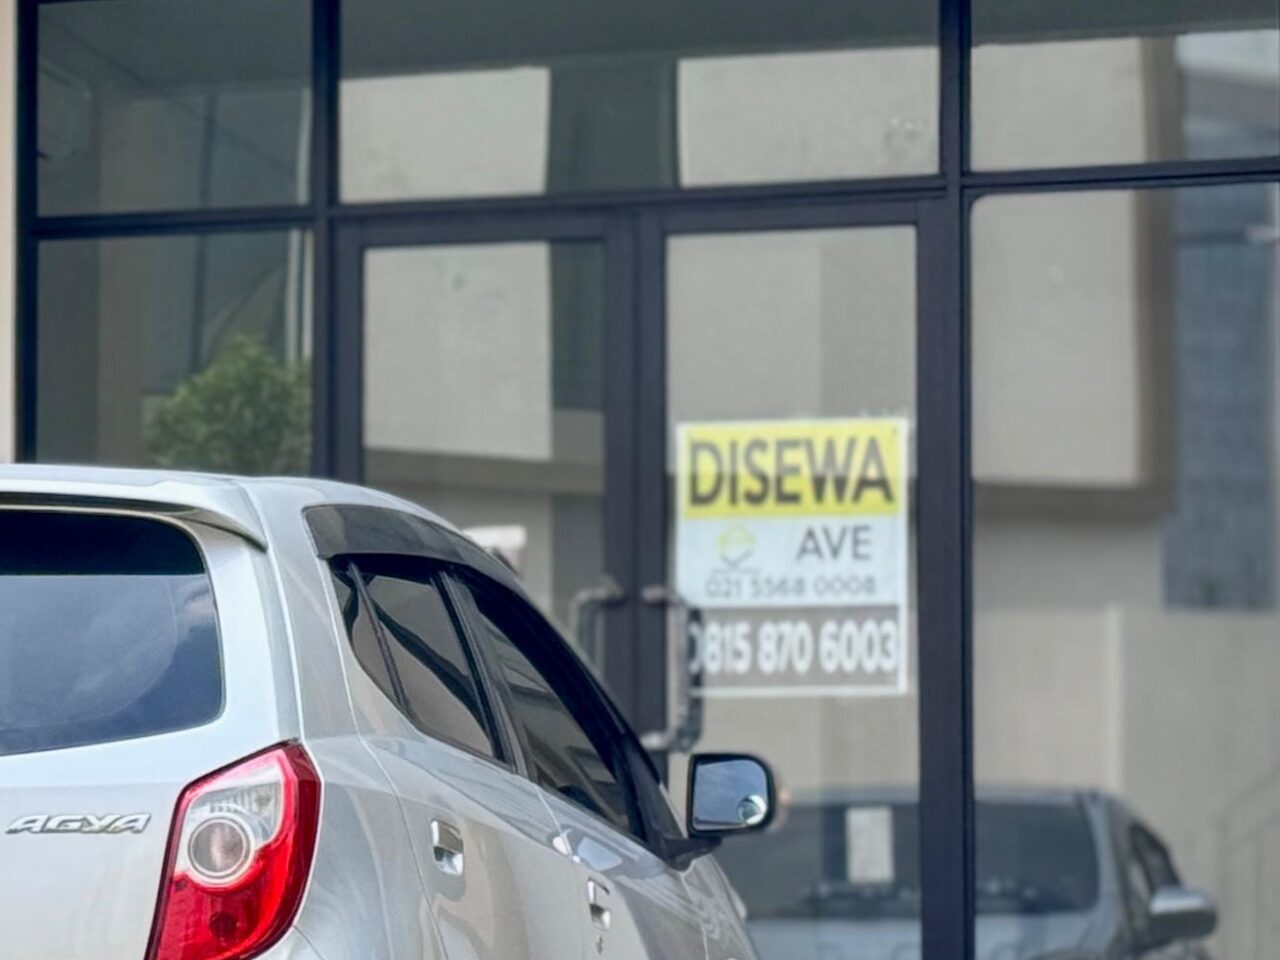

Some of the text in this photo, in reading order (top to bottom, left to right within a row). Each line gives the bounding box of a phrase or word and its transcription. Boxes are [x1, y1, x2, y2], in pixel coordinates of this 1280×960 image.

[689, 437, 896, 507] DISEWA
[795, 525, 873, 561] AVE
[758, 619, 814, 675] 870
[821, 619, 899, 674] 6003
[5, 813, 151, 834] AGYA
